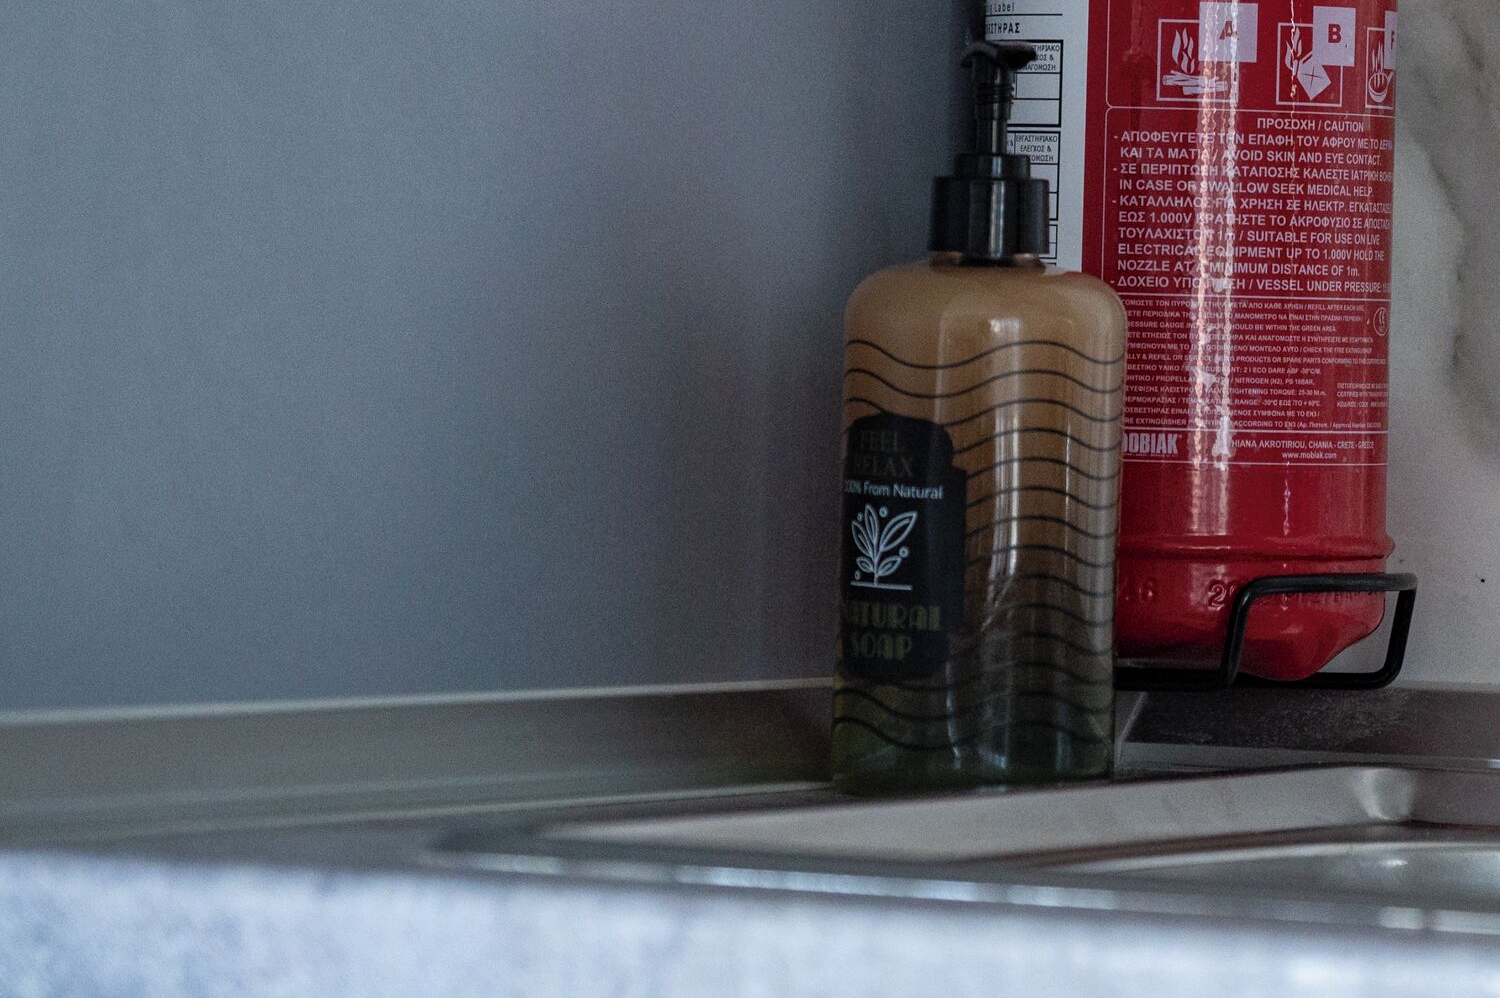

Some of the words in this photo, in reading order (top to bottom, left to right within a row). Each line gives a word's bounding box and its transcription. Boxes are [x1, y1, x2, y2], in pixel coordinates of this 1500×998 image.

[994, 2, 1014, 12] Label
[1219, 20, 1238, 41] A
[1328, 24, 1342, 44] B
[1257, 118, 1316, 130] ΠΡΟΣΟΧΗ
[1324, 120, 1364, 132] CAUTION
[1121, 131, 1214, 144] ΑΠΟΦΕΥΓΕΤΕ
[1248, 134, 1294, 146] ΕΠΑΦΗ
[1297, 136, 1320, 147] ΤΟΥ
[1322, 137, 1356, 148] ΑΦΡΟΥ
[1358, 138, 1368, 149] ΜΕ
[1370, 139, 1379, 150] ΤΟ
[1120, 147, 1142, 158] ΚΑΙ
[1146, 148, 1164, 158] ΤΑ
[1168, 148, 1210, 160] ΜΑΤΙΑ
[1222, 150, 1263, 161] AVOID
[1266, 150, 1295, 162] SKIN
[1298, 152, 1322, 163] AND
[1325, 154, 1344, 164] EYE
[1346, 154, 1382, 166] CONTACT.
[1120, 163, 1136, 174] ΣΕ
[1141, 164, 1218, 176] ΠΕΡΙΠΤΩΣΗ
[1222, 166, 1300, 178] ΚΑΤΑΠΟΣΗΣ
[1303, 168, 1349, 180] ΚΑΛΕΣΤΕ
[1351, 170, 1378, 181] ΙΑΤΡΙΚΗ
[1120, 180, 1132, 190] IN
[1136, 180, 1173, 191] CASE
[1201, 182, 1268, 194] SWALLOW
[1272, 184, 1304, 194] SEEK
[1308, 184, 1351, 196] MEDICAL
[1354, 186, 1374, 197] HELP.
[1120, 196, 1210, 208] ΚΑΤΑΛΛΗΛΟΣ
[1240, 198, 1282, 210] ΧΡΗΣΗ
[1286, 200, 1300, 210] ΣΕ
[1304, 201, 1347, 212] ΗΛΕΚΤΡ.
[1119, 212, 1146, 222] ΕΩΣ
[1150, 212, 1192, 224] 1.000V
[1195, 214, 1266, 226] ΚΡΑΤΗΣΤΕ
[1269, 214, 1286, 226] ΤΟ
[1290, 216, 1350, 228] ΑΚΡΟΦΥΣΙΟ
[1352, 218, 1362, 228] ΣΕ
[1247, 230, 1307, 243] SUITABLE
[1310, 232, 1332, 244] FOR
[1334, 234, 1352, 244] USE
[1354, 234, 1366, 244] ON
[1366, 234, 1380, 246] LIVE
[1118, 244, 1203, 256] ELECTRICAL
[1206, 246, 1283, 258] EQUIPMENT
[1286, 248, 1302, 259] UP
[1306, 249, 1320, 260] TO
[1324, 250, 1351, 260] 1.000V
[1354, 250, 1374, 262] HOLD
[1374, 251, 1384, 262] THE
[1118, 260, 1170, 272] NOZZLE
[1174, 262, 1192, 272] AT
[1210, 262, 1268, 274] MINIMUM
[1272, 264, 1328, 276] DISTANCE
[1331, 265, 1344, 276] OF
[1347, 266, 1360, 276] 1m.
[1118, 276, 1168, 288] ΔΟΧΕΙΟ
[1173, 278, 1200, 288] ΥΠΟ
[1256, 280, 1303, 291] VESSEL
[1307, 281, 1342, 292] UNDER
[1344, 282, 1381, 293] PRESSURE
[1258, 440, 1306, 449] AKROTIRIOU,
[863, 481, 890, 497] From
[893, 483, 944, 500] Natural
[847, 600, 942, 632] ATURAL
